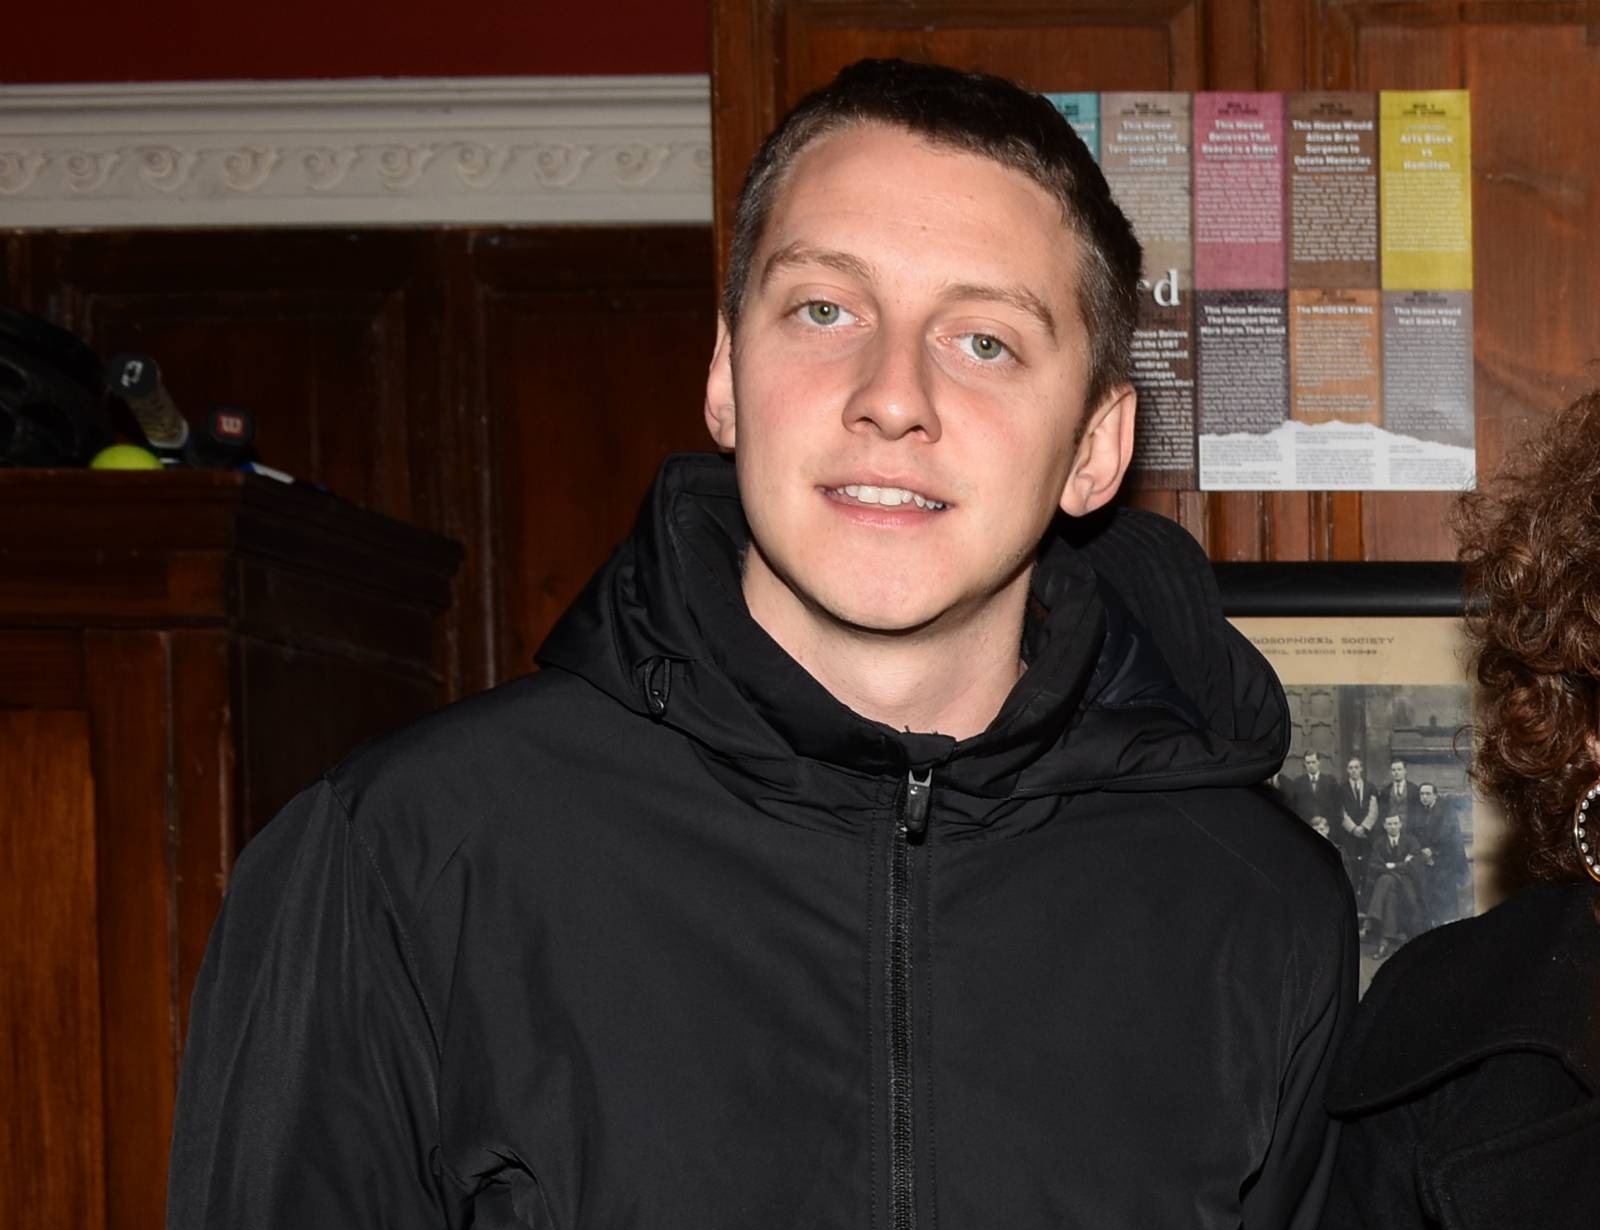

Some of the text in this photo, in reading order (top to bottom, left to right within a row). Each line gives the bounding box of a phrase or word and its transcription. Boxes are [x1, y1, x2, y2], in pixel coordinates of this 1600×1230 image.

[1143, 120, 1172, 130] House
[1215, 120, 1264, 130] This House
[1292, 120, 1373, 131] This House Would
[1116, 132, 1178, 142] Believes That
[1208, 132, 1271, 142] Believes That
[1306, 133, 1360, 142] Allow Brain
[1400, 134, 1453, 144] Arts Block
[1305, 144, 1349, 154] Surgeons
[1293, 156, 1372, 166] Delete Memories
[1403, 160, 1450, 170] Hamilton
[1222, 306, 1246, 314] House
[1247, 306, 1281, 314] Believes
[1312, 306, 1349, 314] MAIDENS
[1350, 306, 1374, 314] FINAL
[1394, 306, 1410, 316] This
[1412, 306, 1436, 316] House
[1250, 636, 1394, 644] LOSOPHICAL SOCIETY
